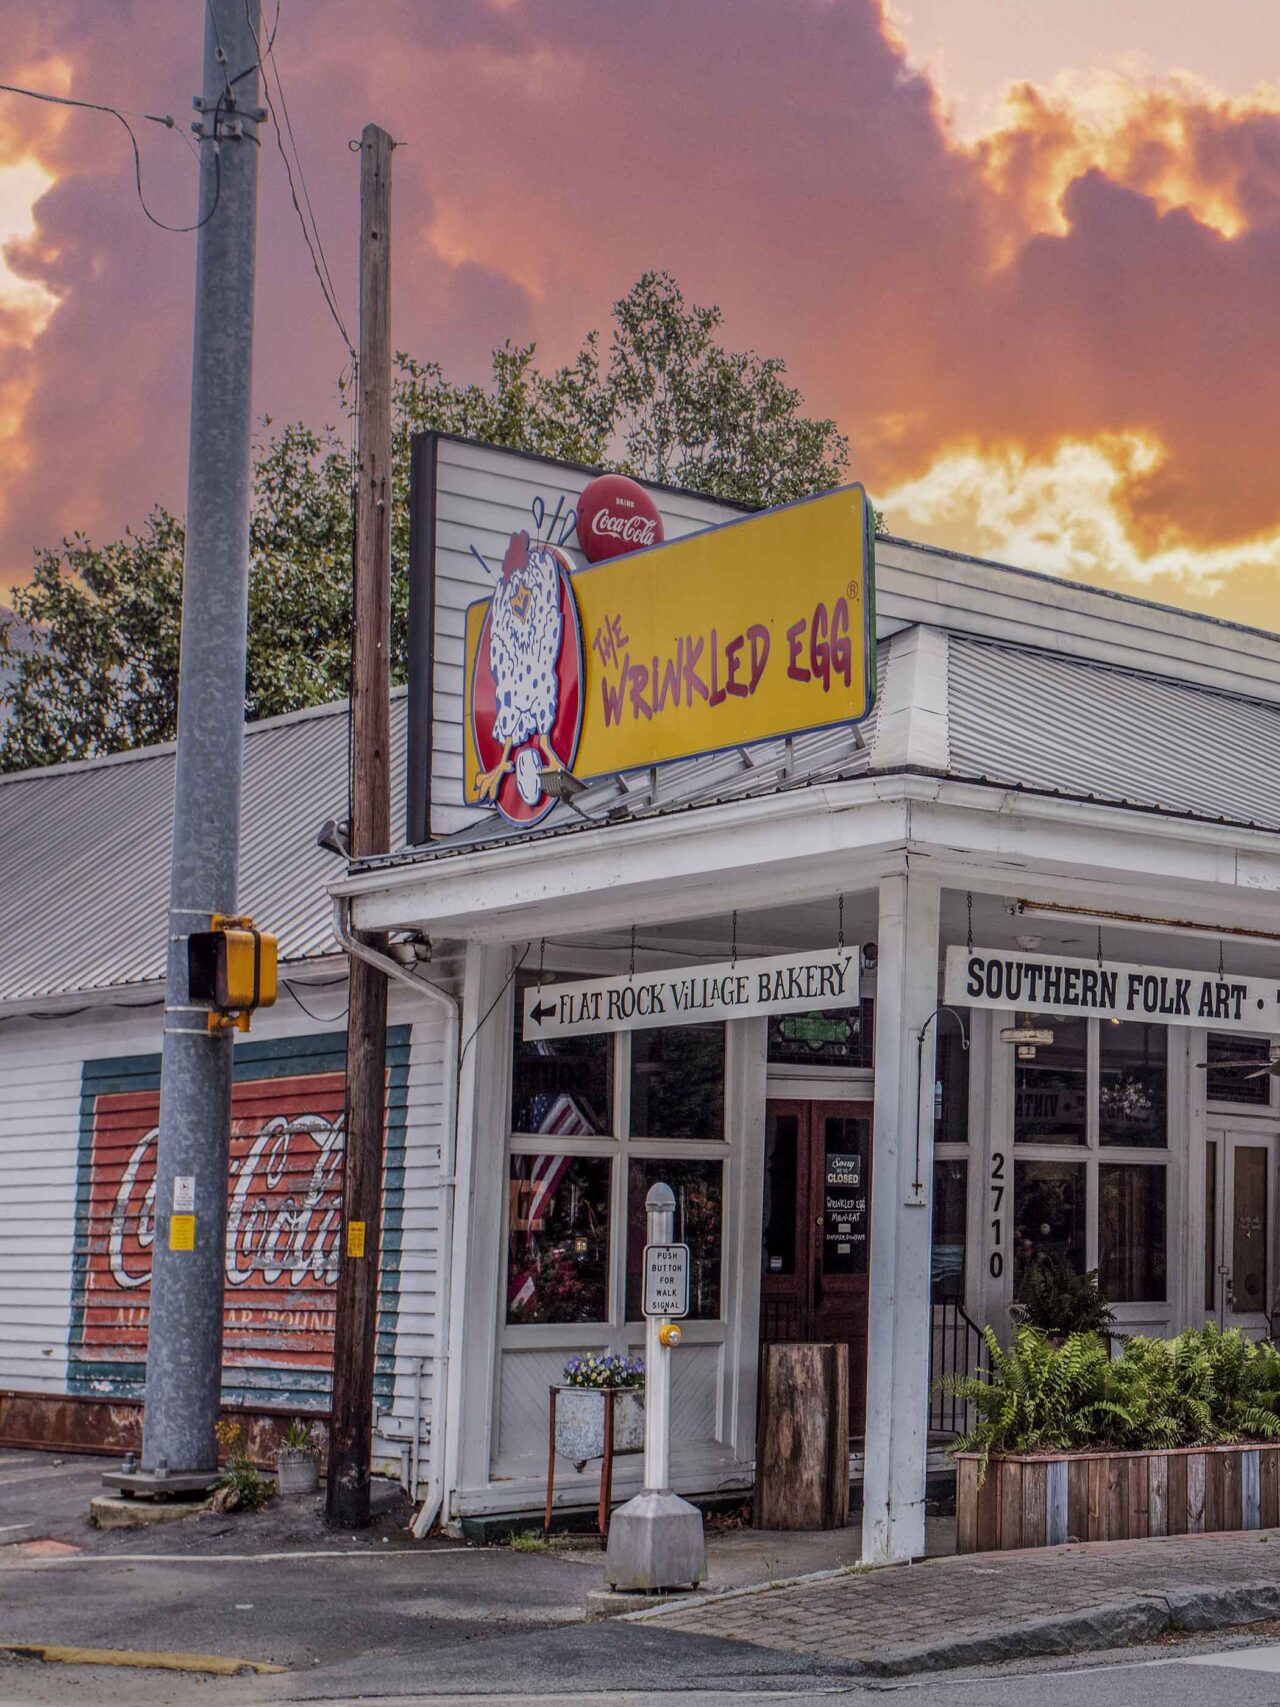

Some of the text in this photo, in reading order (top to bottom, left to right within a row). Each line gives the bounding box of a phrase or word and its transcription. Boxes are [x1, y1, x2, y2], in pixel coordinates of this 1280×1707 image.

[615, 497, 635, 509] DRINK
[591, 508, 657, 546] Coca-Cola
[593, 613, 629, 670] THE
[601, 597, 852, 728] WRINKLED EGG
[559, 992, 604, 1025] FLAT
[606, 983, 666, 1020] ROCK
[757, 956, 853, 1004] BAKERY
[966, 957, 1118, 1010] SOUTHERN
[1126, 973, 1192, 1017] FOLK
[1198, 981, 1248, 1021] ART
[831, 1157, 855, 1171] Sorry
[827, 1173, 859, 1184] CLOSED
[989, 1152, 1005, 1278] 2710
[657, 1252, 678, 1260] PUSH
[651, 1264, 682, 1272] BUTTON
[659, 1276, 675, 1284] FOR
[656, 1289, 677, 1297] WALK
[652, 1301, 680, 1309] SIGNAL
